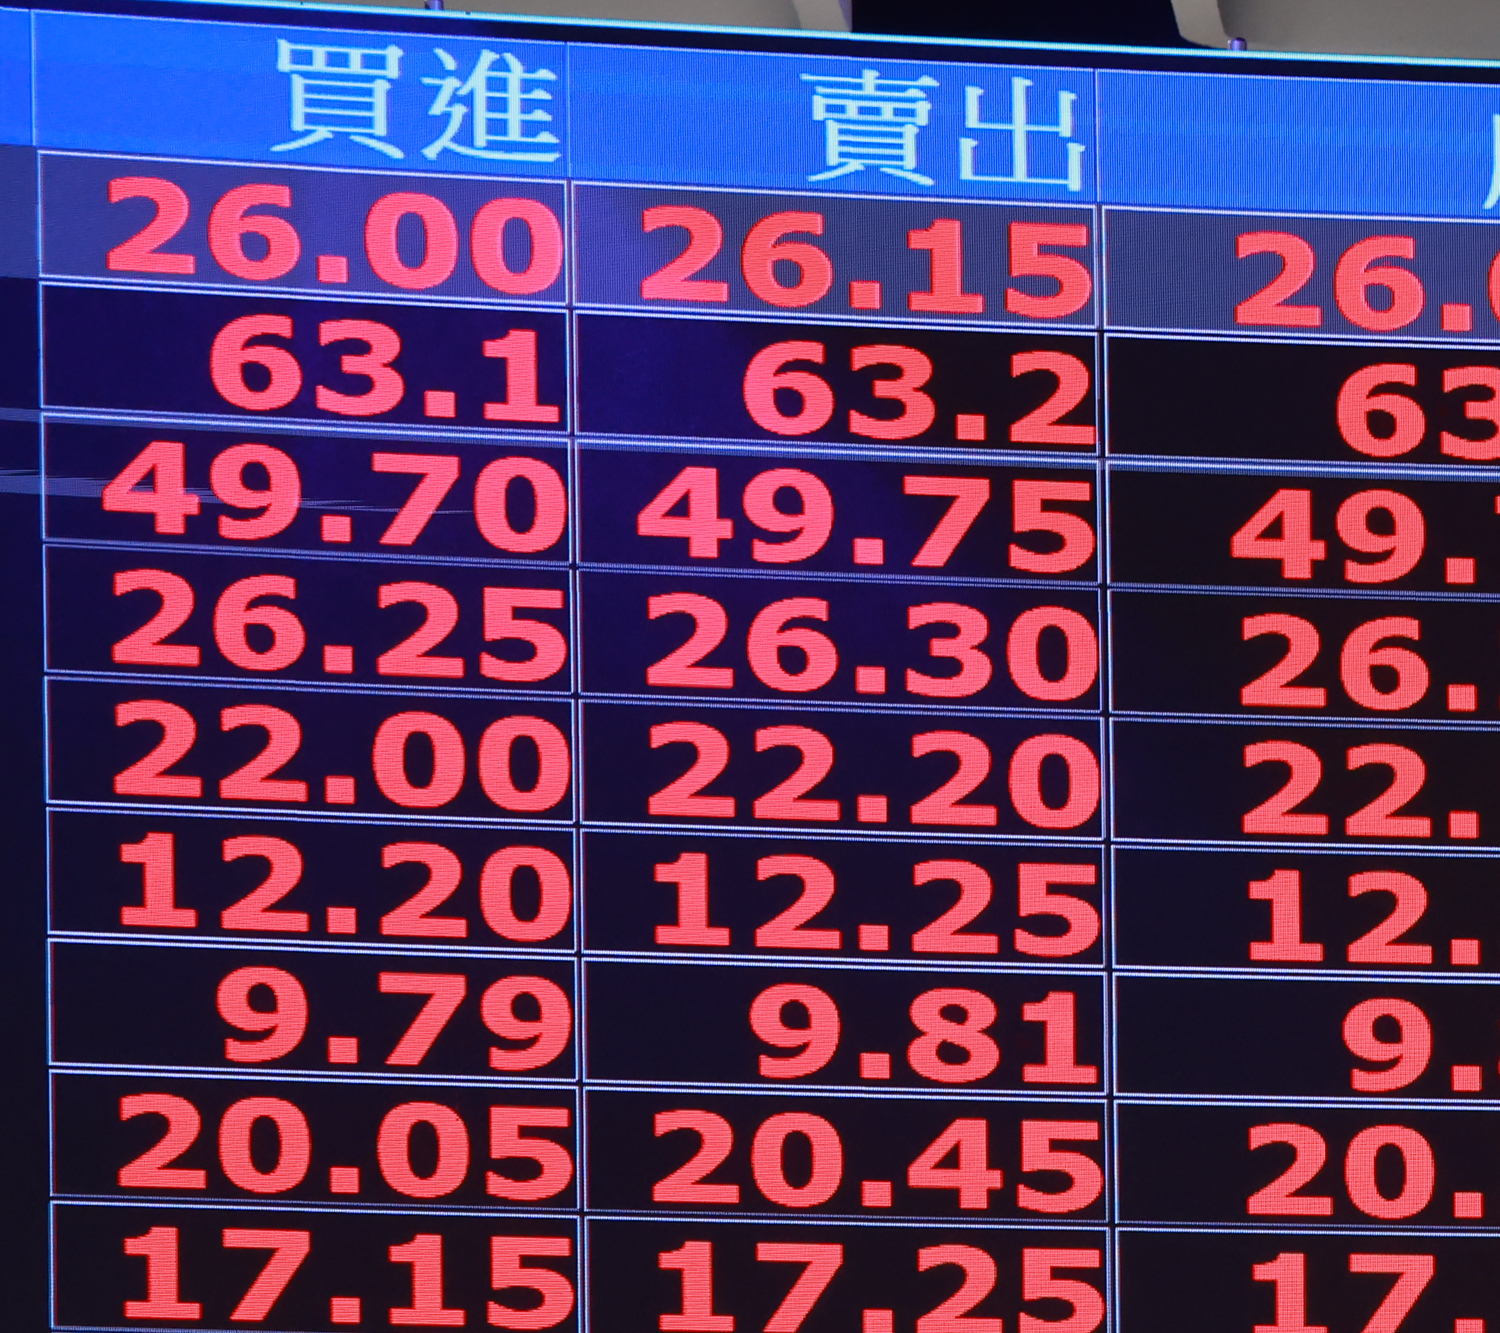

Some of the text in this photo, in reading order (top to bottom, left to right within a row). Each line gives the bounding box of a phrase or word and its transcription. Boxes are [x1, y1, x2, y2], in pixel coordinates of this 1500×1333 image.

[268, 40, 560, 162] 買進
[802, 70, 1085, 193] 賣出
[107, 177, 562, 294] 26.00
[641, 205, 1092, 319] 26.15
[113, 699, 571, 812] 22.00
[648, 721, 1101, 829] 22.20
